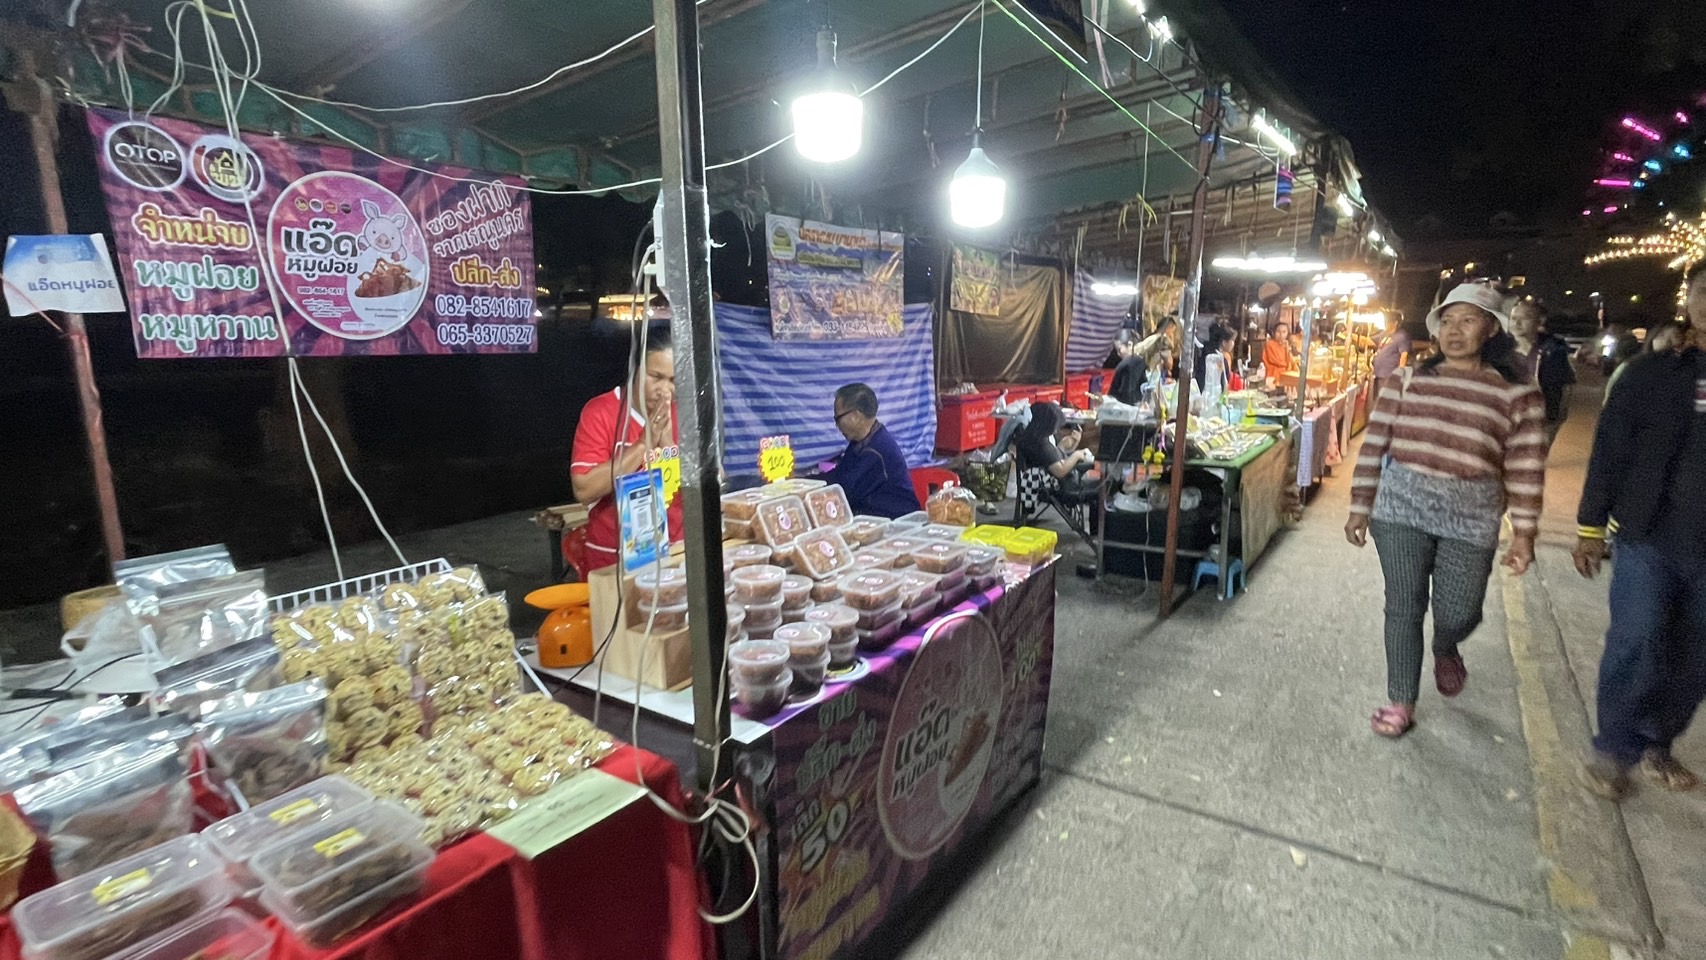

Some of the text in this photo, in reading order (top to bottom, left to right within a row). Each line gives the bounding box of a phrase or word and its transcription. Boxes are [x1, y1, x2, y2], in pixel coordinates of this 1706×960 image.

[115, 142, 176, 163] OTOP
[134, 205, 250, 248] จำหน่าย
[428, 180, 512, 235] ของฝาก
[284, 220, 358, 258] แอ๊ด
[434, 208, 524, 257] จากเรณูนคร
[135, 255, 259, 301] หมูฝอย
[287, 258, 358, 279] หมูฝอย
[451, 255, 521, 288] ปลีก-ส่ง
[436, 294, 532, 318] 082-8541617
[139, 314, 278, 353] หมูหวาน
[438, 323, 534, 345] 065-3370527
[767, 455, 786, 472] 100
[894, 699, 951, 772] แอ๊ด
[801, 802, 849, 876] 50
